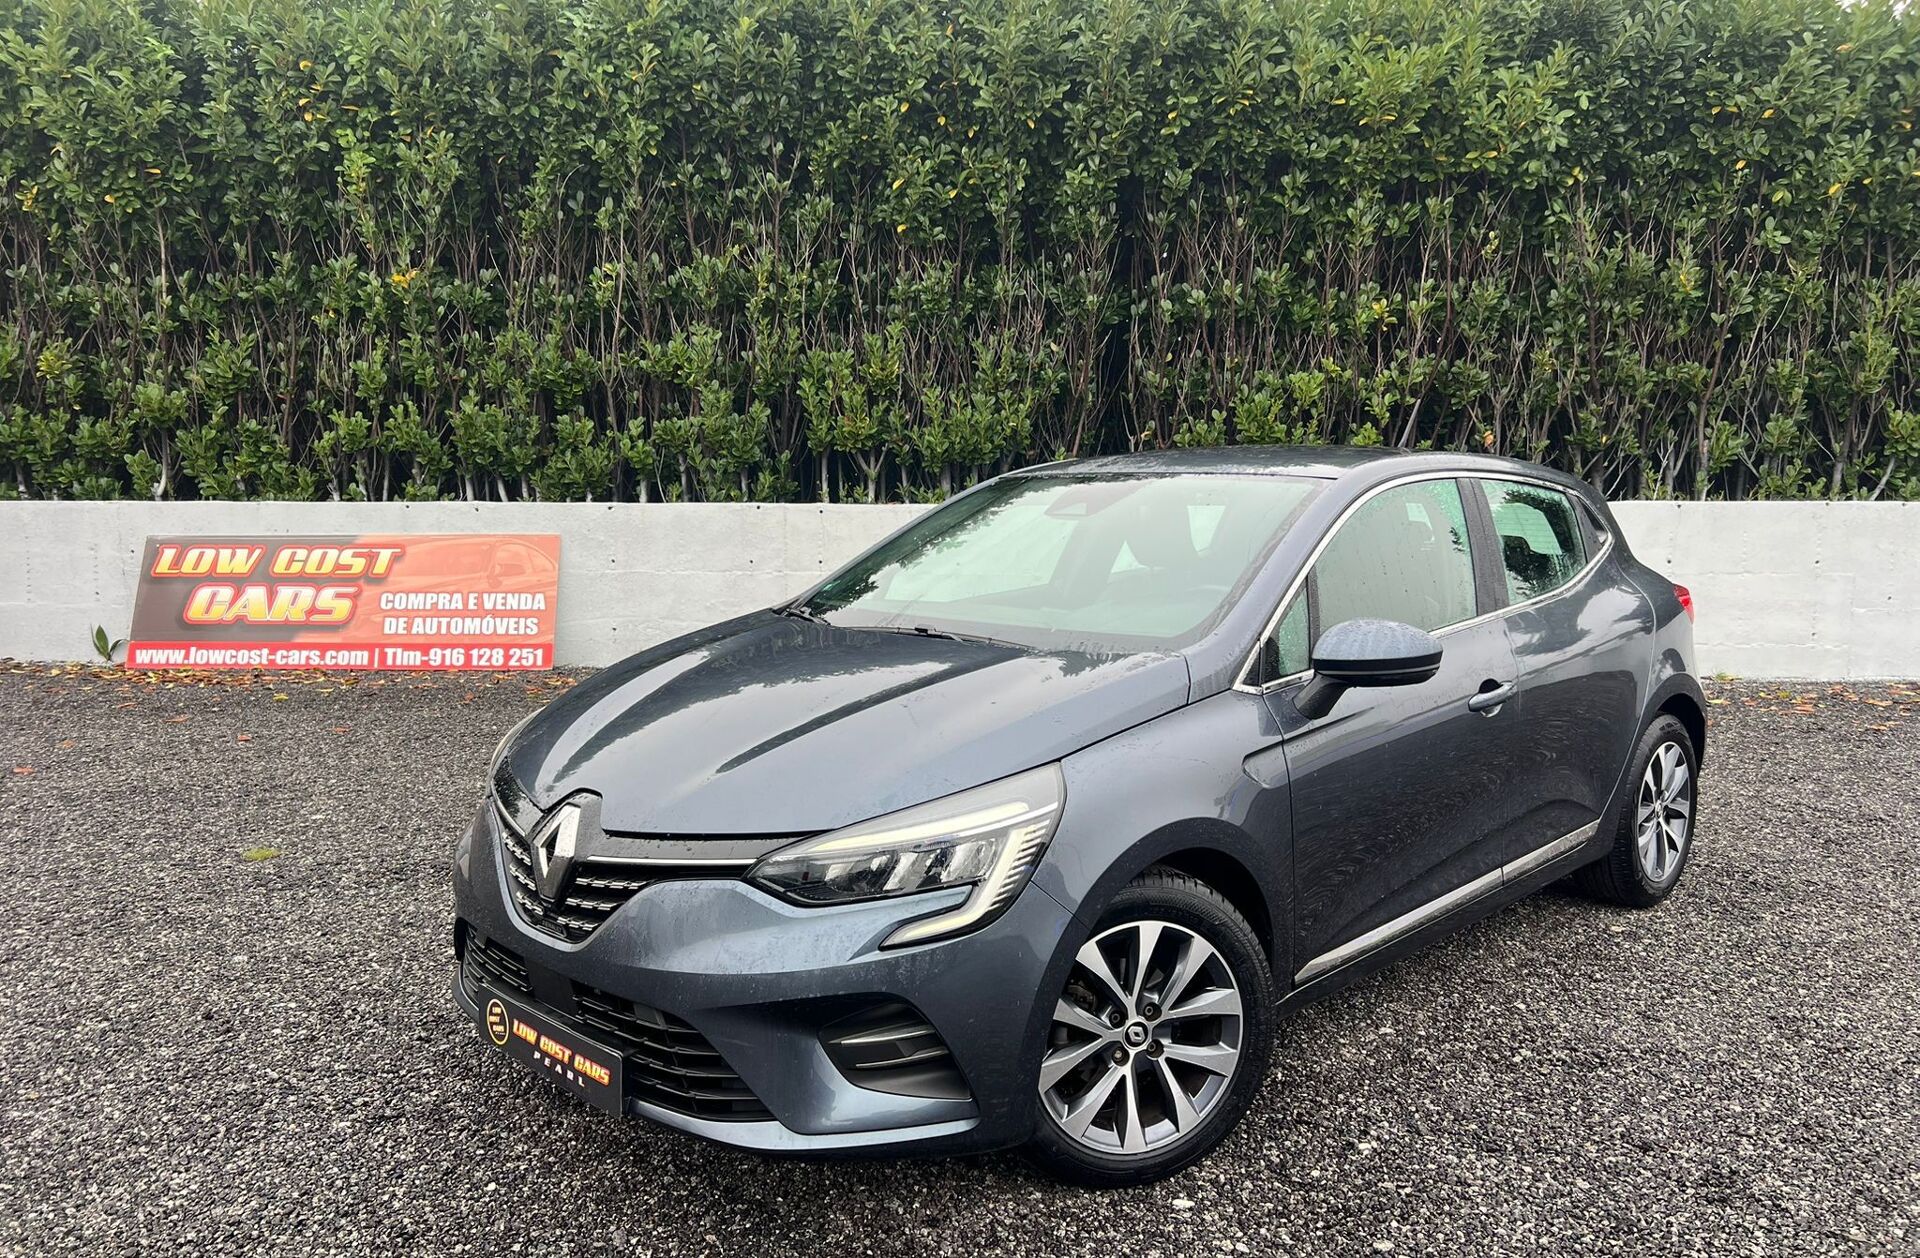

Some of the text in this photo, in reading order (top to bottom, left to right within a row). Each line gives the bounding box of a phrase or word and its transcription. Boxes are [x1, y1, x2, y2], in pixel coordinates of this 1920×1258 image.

[152, 545, 404, 577] LOW COST
[184, 583, 361, 624] CARS
[380, 592, 546, 610] COMPRA E VENDA
[383, 615, 539, 635] DE AUTOMÓVEIS
[135, 646, 369, 666] www.lowcost-cars.com
[469, 648, 504, 666] 128
[508, 648, 544, 666] 251
[512, 1018, 611, 1086] LOW COST CARS
[533, 1051, 585, 1087] PEARL
